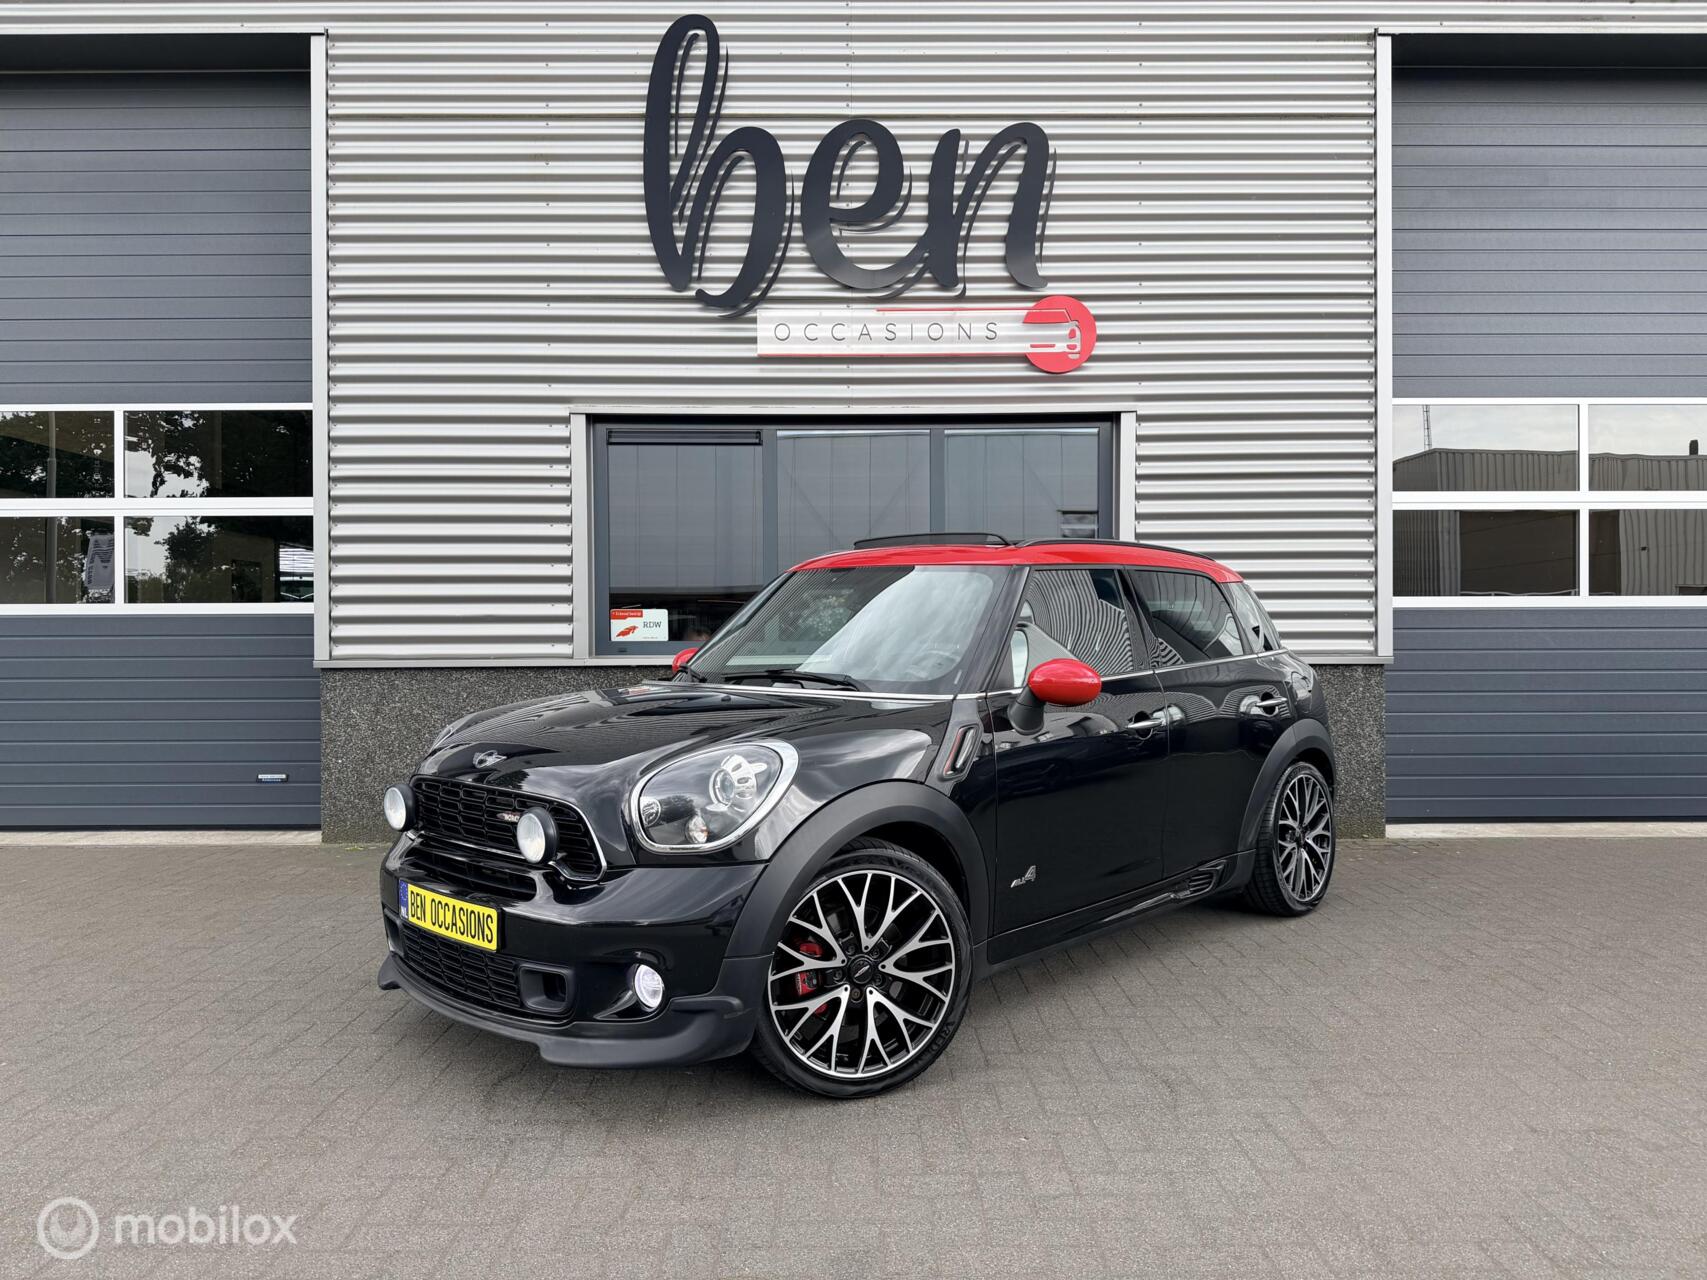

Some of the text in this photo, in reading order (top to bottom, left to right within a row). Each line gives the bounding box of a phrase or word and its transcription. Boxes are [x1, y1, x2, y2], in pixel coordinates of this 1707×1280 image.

[644, 14, 1055, 310] ben
[774, 322, 998, 342] OCCASIONS
[642, 621, 662, 629] RDW
[400, 905, 409, 919] NL
[410, 890, 494, 944] BEN OCCASIONS
